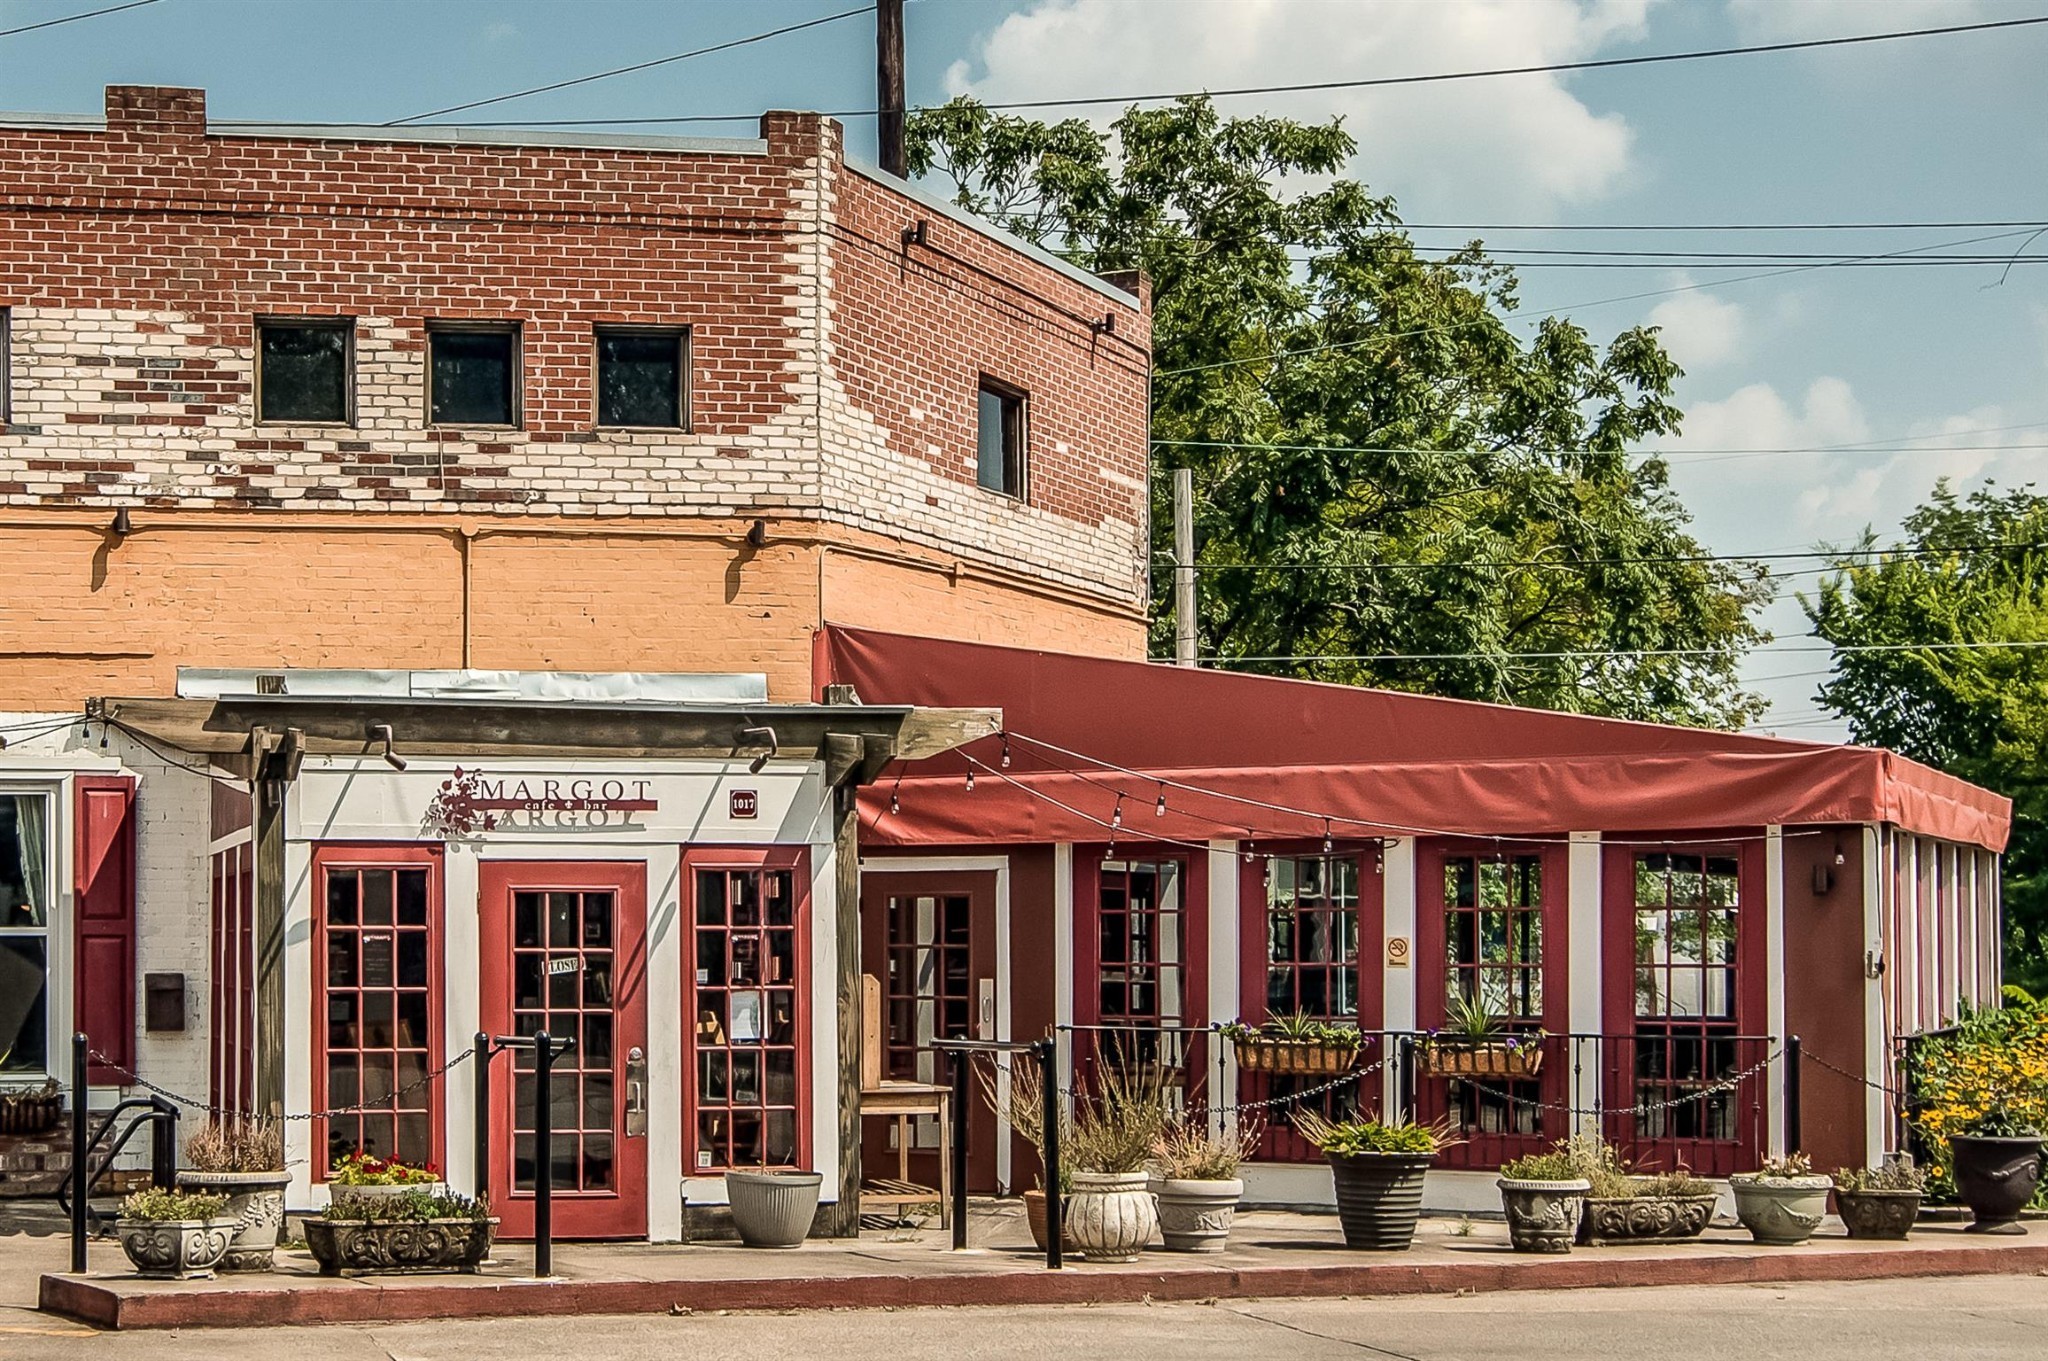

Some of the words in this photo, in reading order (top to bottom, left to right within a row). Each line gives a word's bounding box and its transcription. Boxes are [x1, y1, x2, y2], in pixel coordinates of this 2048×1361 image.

[481, 780, 651, 801] MARGOT
[525, 800, 555, 811] cafe
[583, 800, 608, 811] bar
[733, 799, 755, 809] 1017
[546, 957, 585, 973] LOSE
